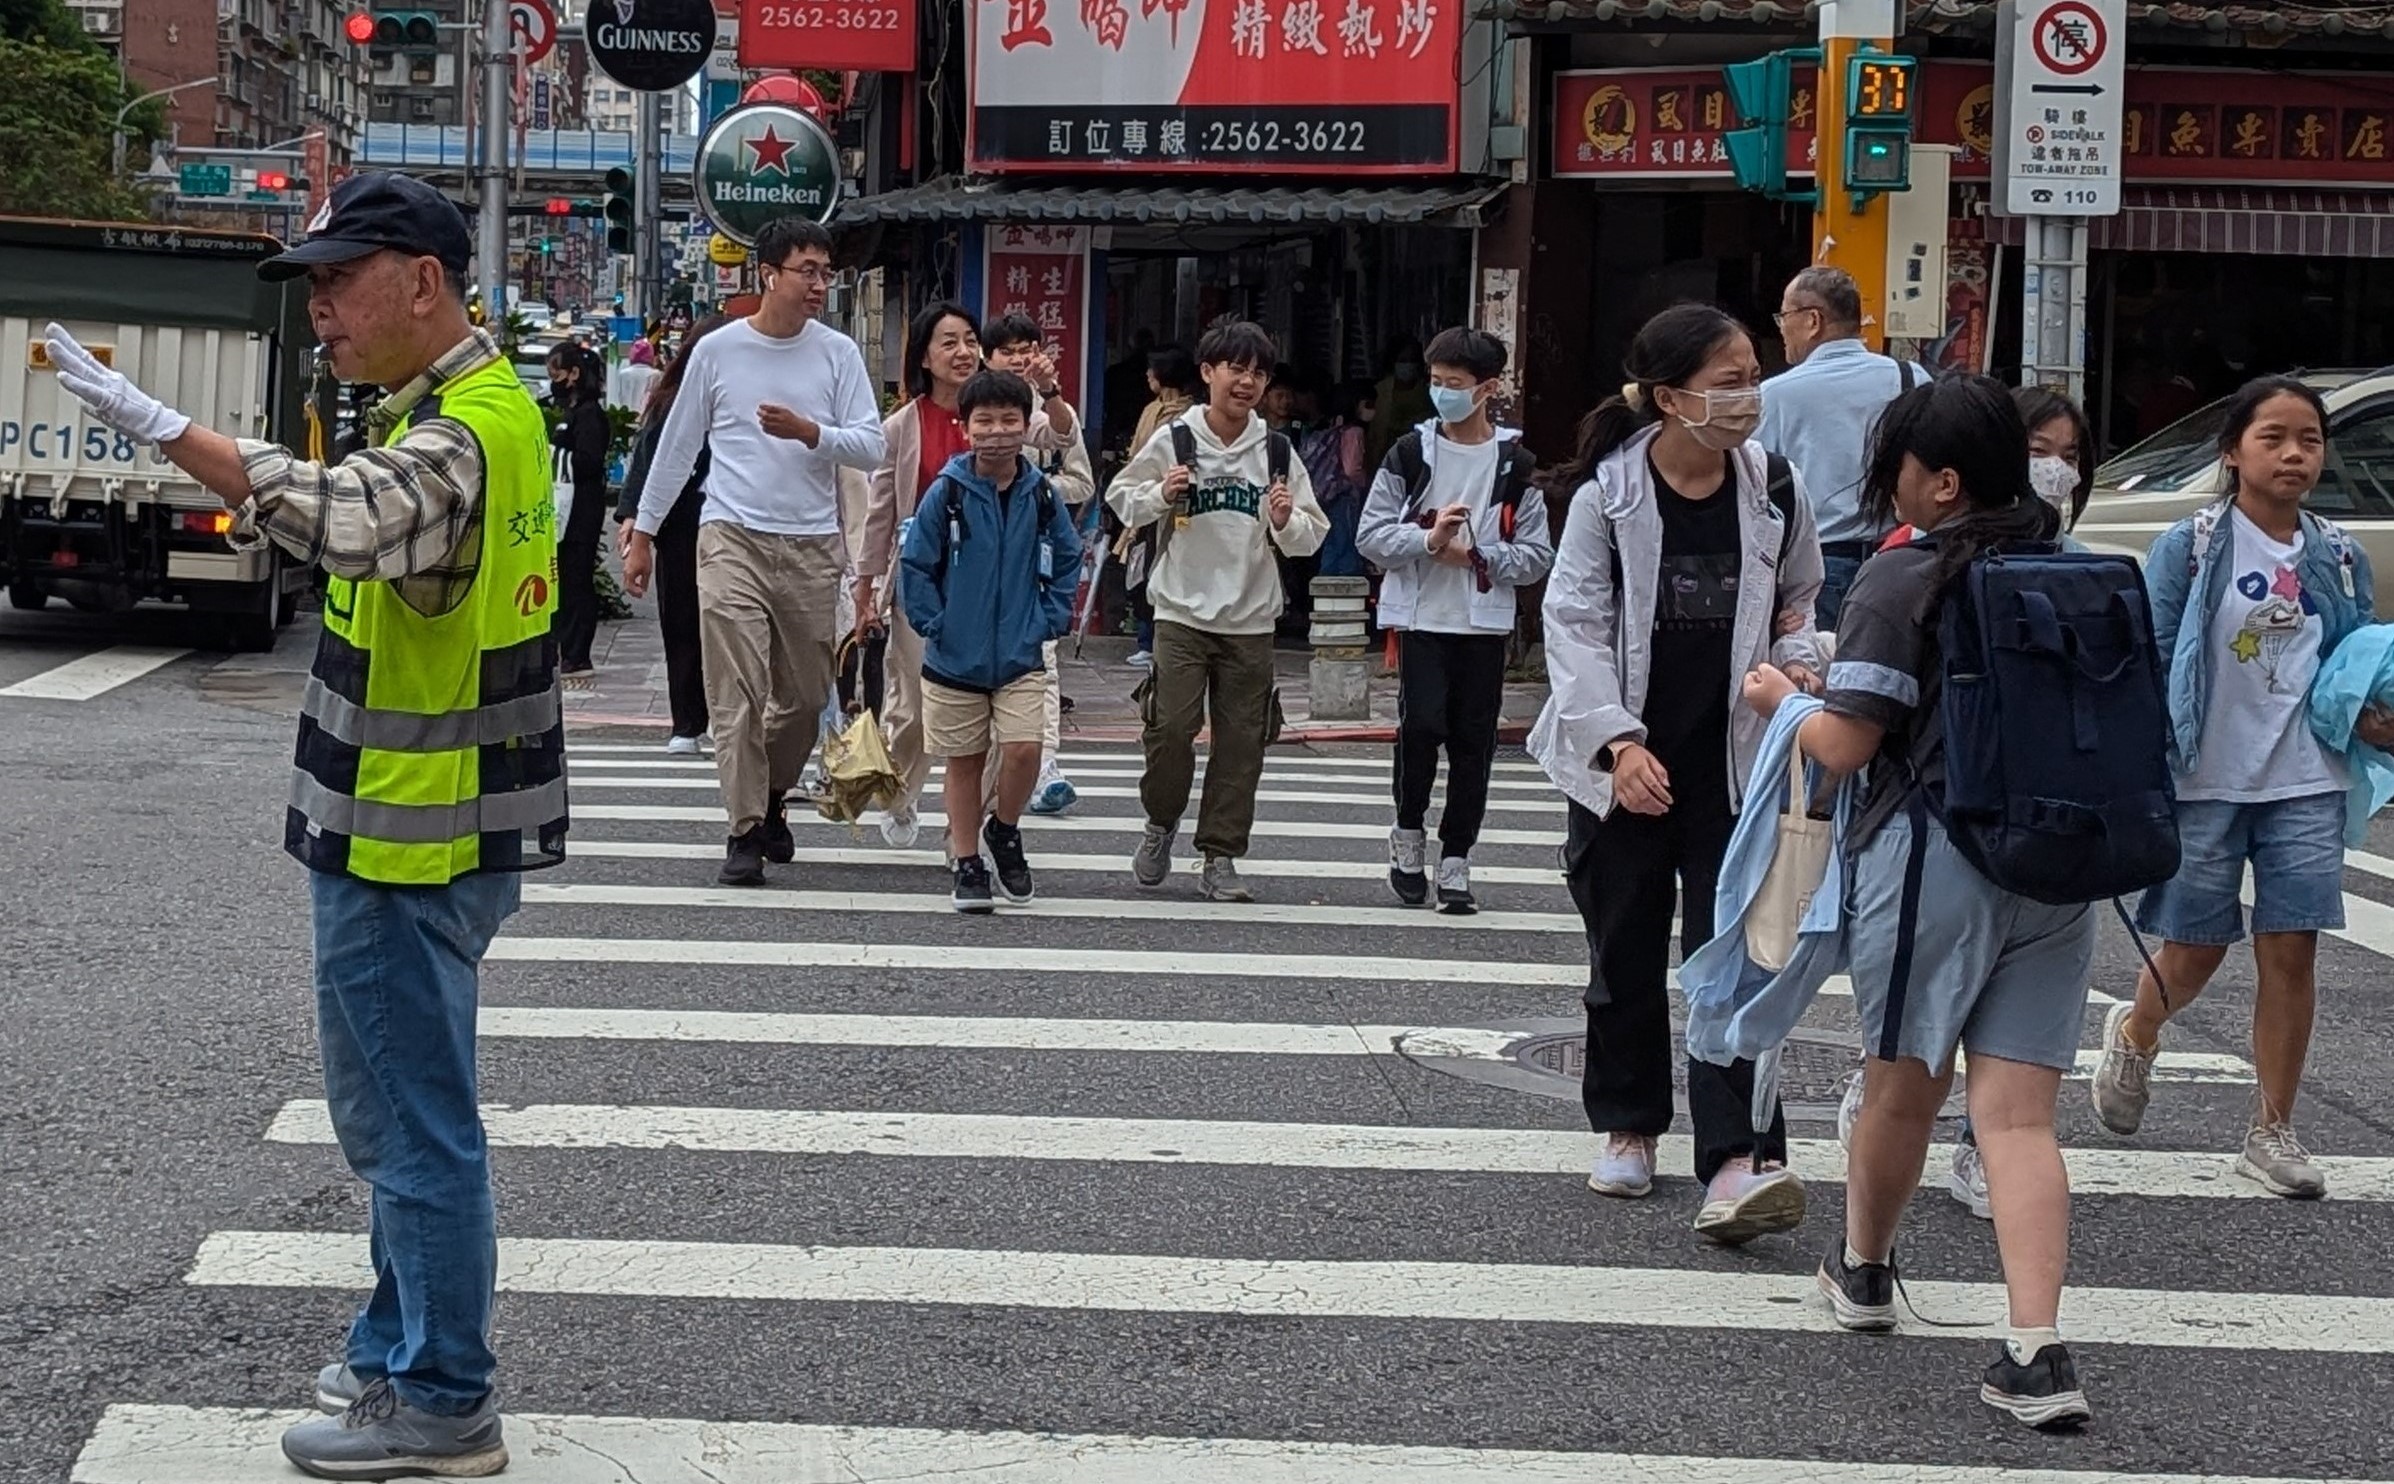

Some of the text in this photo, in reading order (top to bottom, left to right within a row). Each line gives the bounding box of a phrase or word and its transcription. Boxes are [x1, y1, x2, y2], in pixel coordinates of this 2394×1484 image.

[760, 6, 898, 29] 2562-3622
[1231, 1, 1437, 60] 精緻熱炒
[597, 23, 702, 53] GUINNESS
[2051, 19, 2089, 58] 停
[1863, 65, 1905, 115] 37
[1048, 120, 1365, 155] 訂位專線 :2562-3622
[2050, 129, 2106, 142] SIDEWALK
[2031, 146, 2100, 162] 違者拖吊
[2021, 164, 2108, 176] TOW-AWAY ZONE
[715, 181, 821, 205] Heineken
[2064, 191, 2097, 204] 110
[1, 421, 169, 464] PC158
